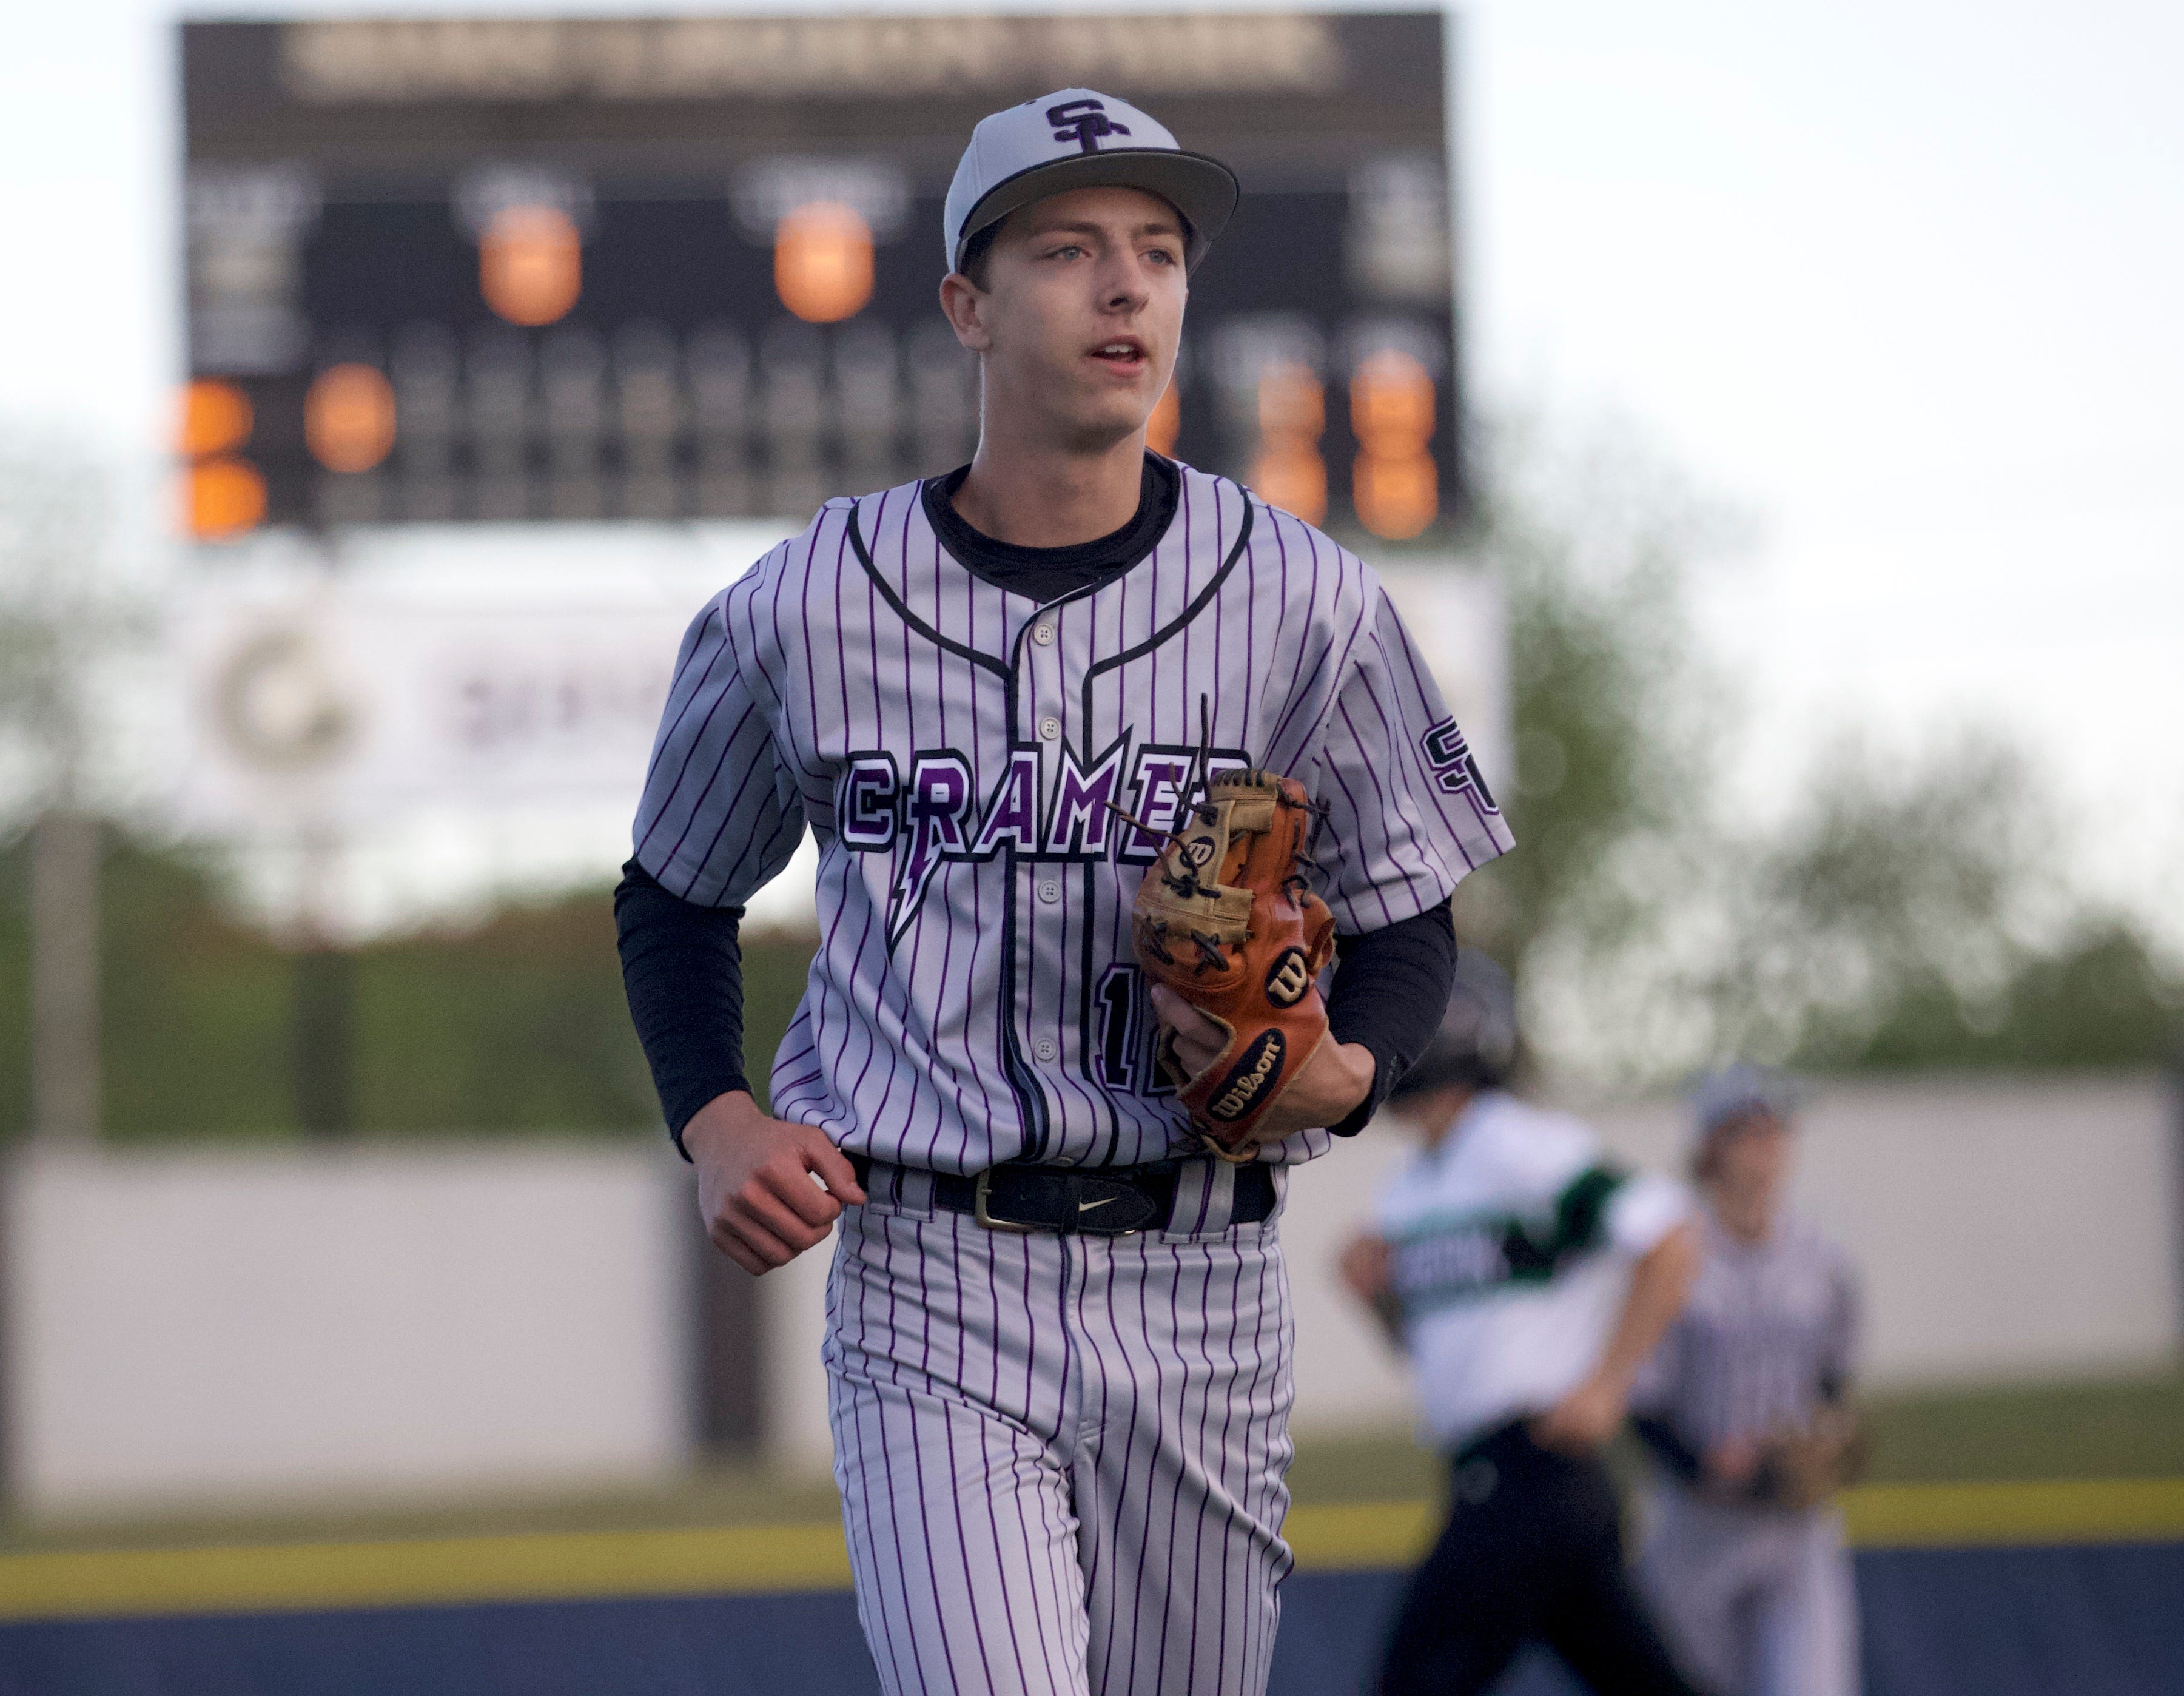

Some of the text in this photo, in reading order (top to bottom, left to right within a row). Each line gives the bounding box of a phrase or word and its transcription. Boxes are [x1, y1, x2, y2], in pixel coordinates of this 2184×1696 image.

[841, 728, 1253, 942] CRAME
[1094, 963, 1177, 1097] 1
[1212, 1041, 1282, 1119] Wilson
